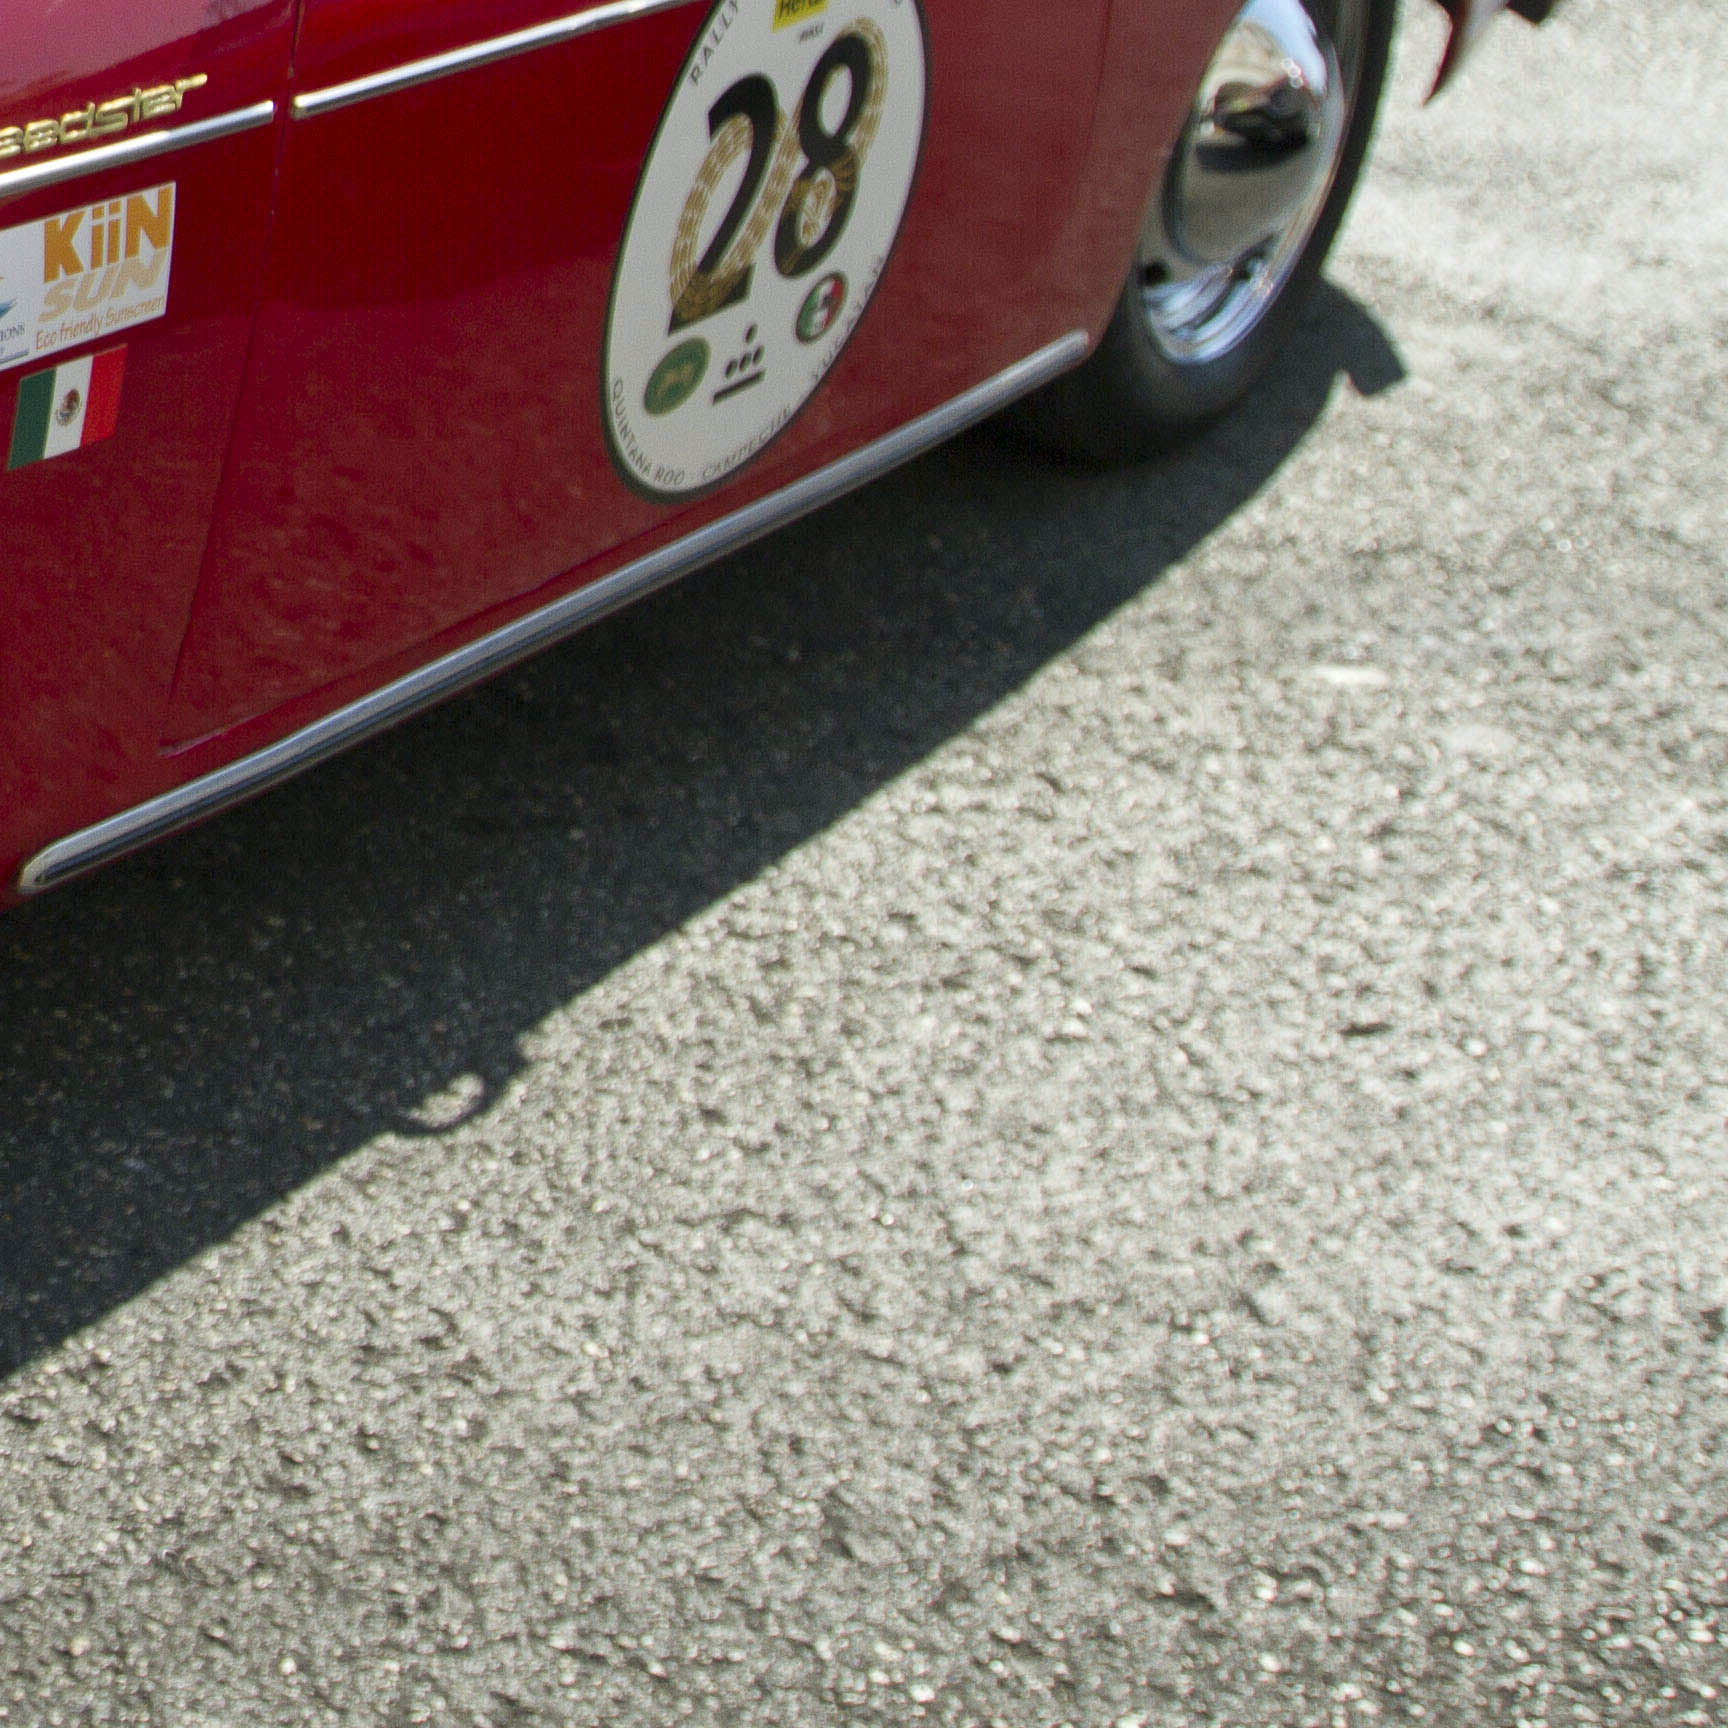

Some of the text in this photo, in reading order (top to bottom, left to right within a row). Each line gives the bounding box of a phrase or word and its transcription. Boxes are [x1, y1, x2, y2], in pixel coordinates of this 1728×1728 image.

[667, 32, 876, 336] 28
[35, 295, 164, 351] Eco friendly Sunscreen
[39, 250, 168, 324] SUN
[613, 376, 653, 474] QUINTANA
[656, 465, 686, 486] ROO
